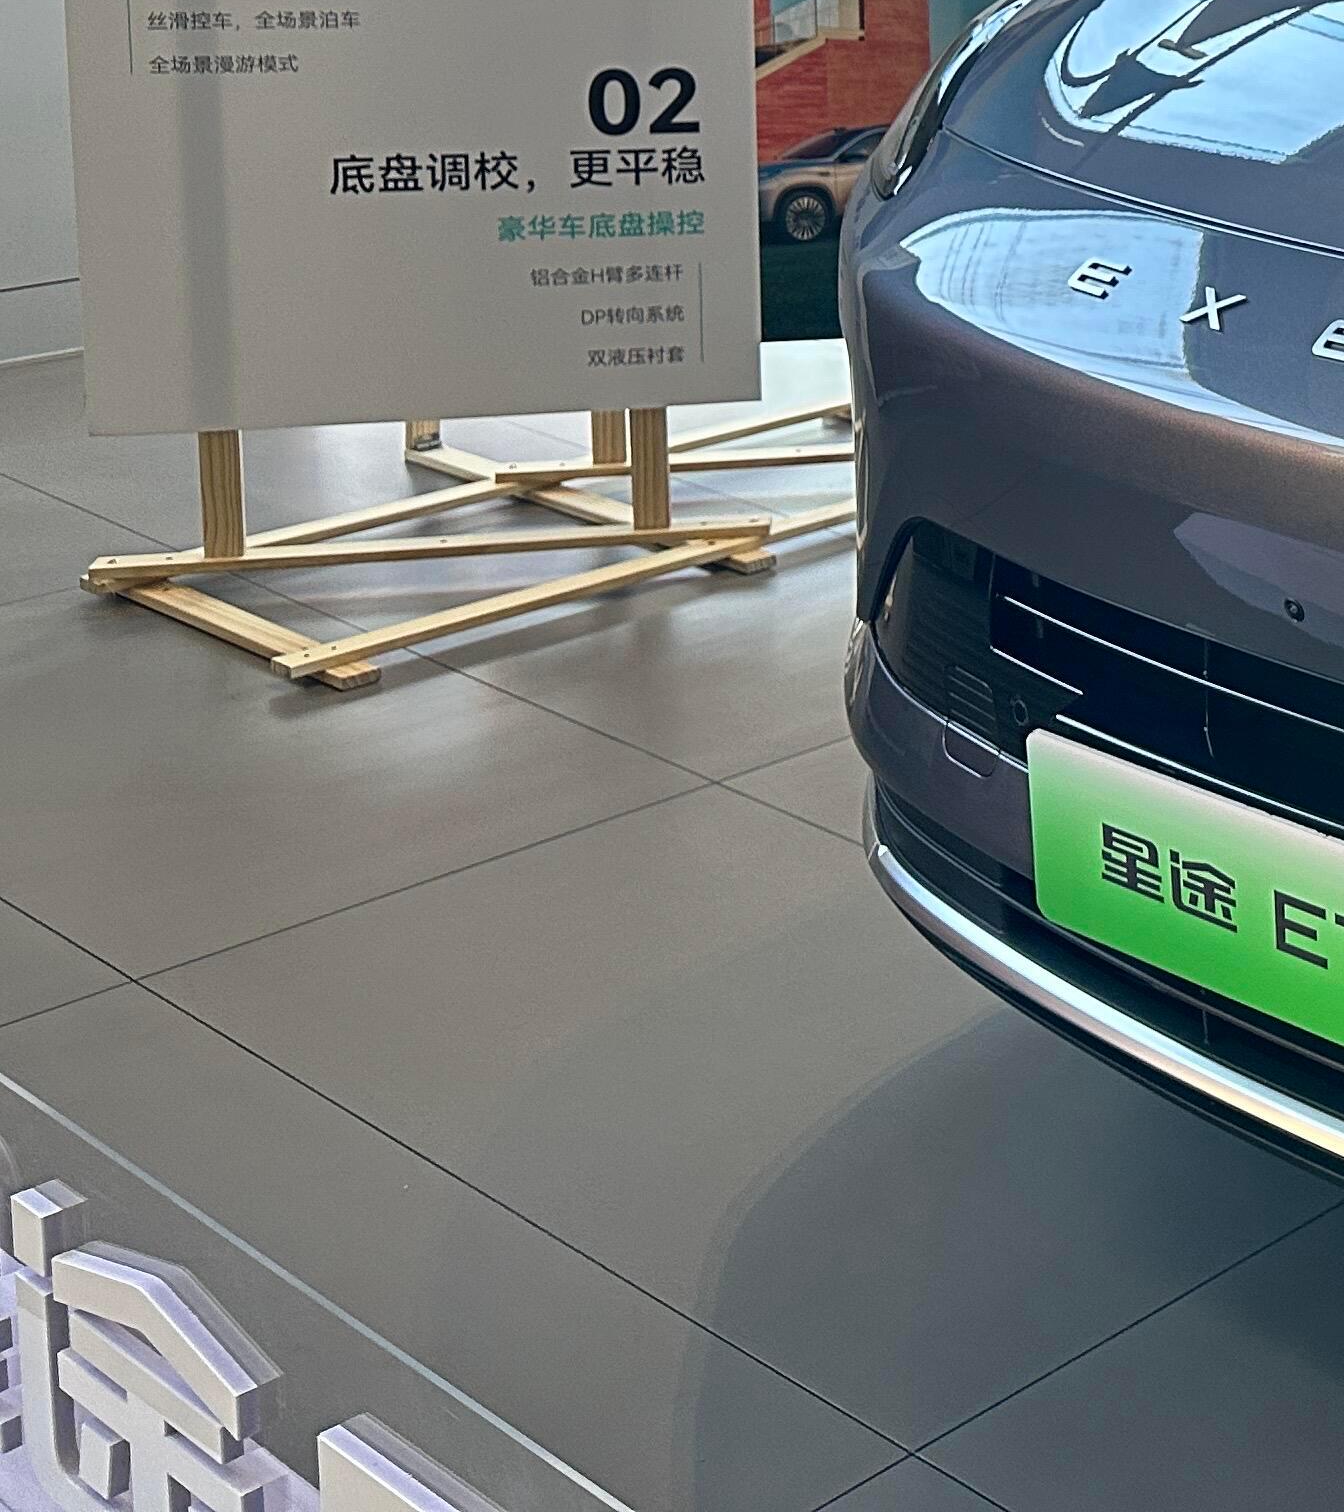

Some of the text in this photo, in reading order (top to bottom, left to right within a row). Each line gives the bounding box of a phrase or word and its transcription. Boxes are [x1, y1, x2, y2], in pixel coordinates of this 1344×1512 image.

[149, 54, 299, 75] 全场景漫游模式
[588, 68, 700, 136] 02
[330, 145, 705, 195] 底盘调校，更平稳
[498, 210, 705, 242] 豪华车底盘操控
[1101, 822, 1238, 934] 星途
